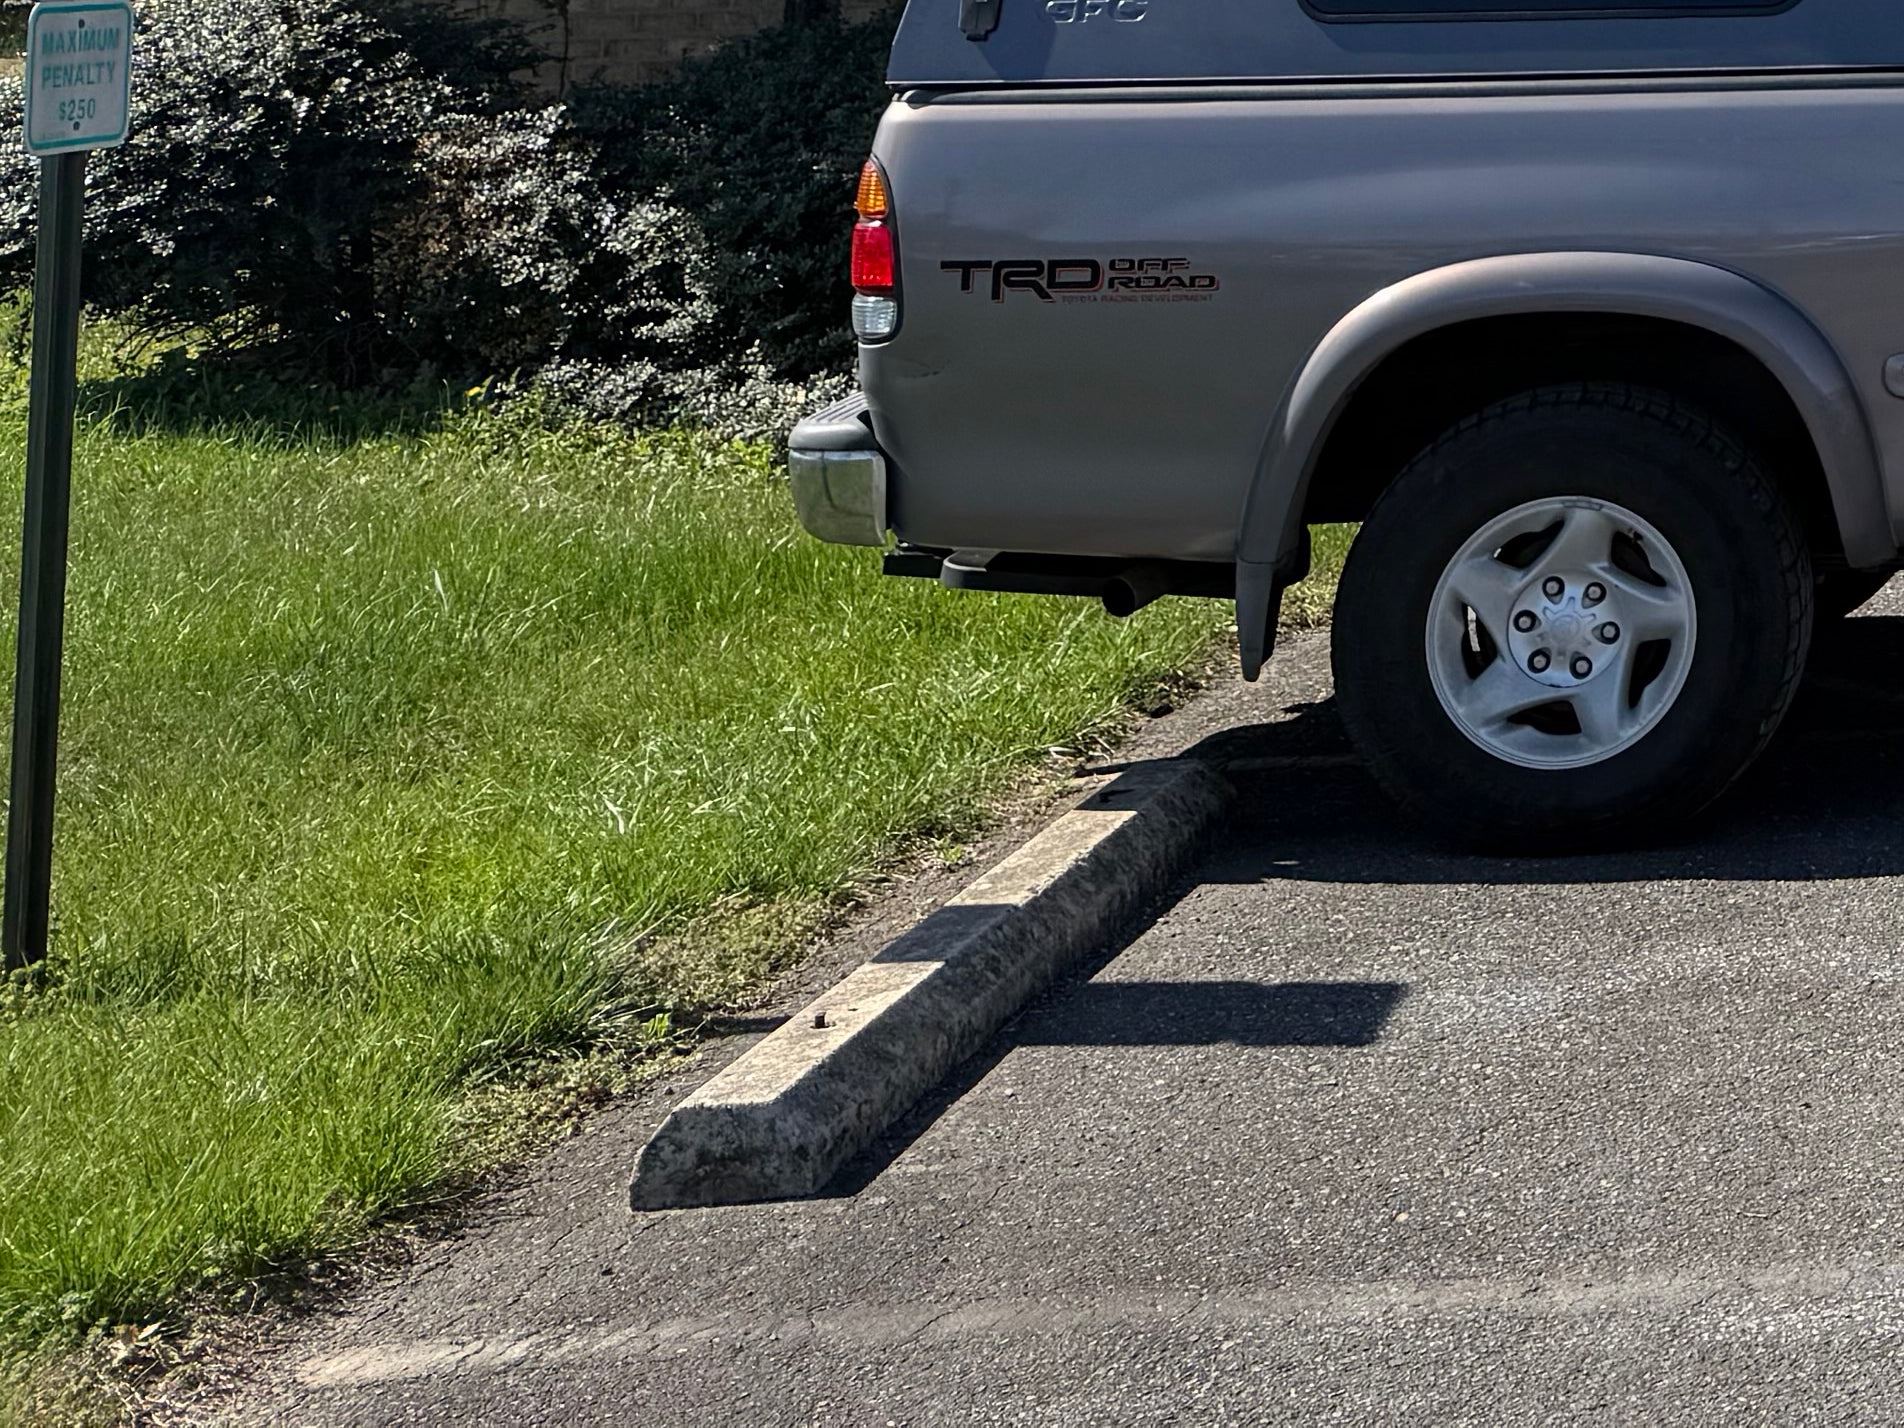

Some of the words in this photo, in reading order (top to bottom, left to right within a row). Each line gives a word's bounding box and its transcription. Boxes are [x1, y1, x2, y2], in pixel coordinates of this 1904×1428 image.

[41, 28, 119, 55] MAXIMUM
[41, 61, 116, 90] PENALTY
[58, 98, 97, 121] $250
[940, 258, 1104, 304] TRD
[1107, 257, 1192, 274] OFF
[1107, 275, 1219, 292] ROAD
